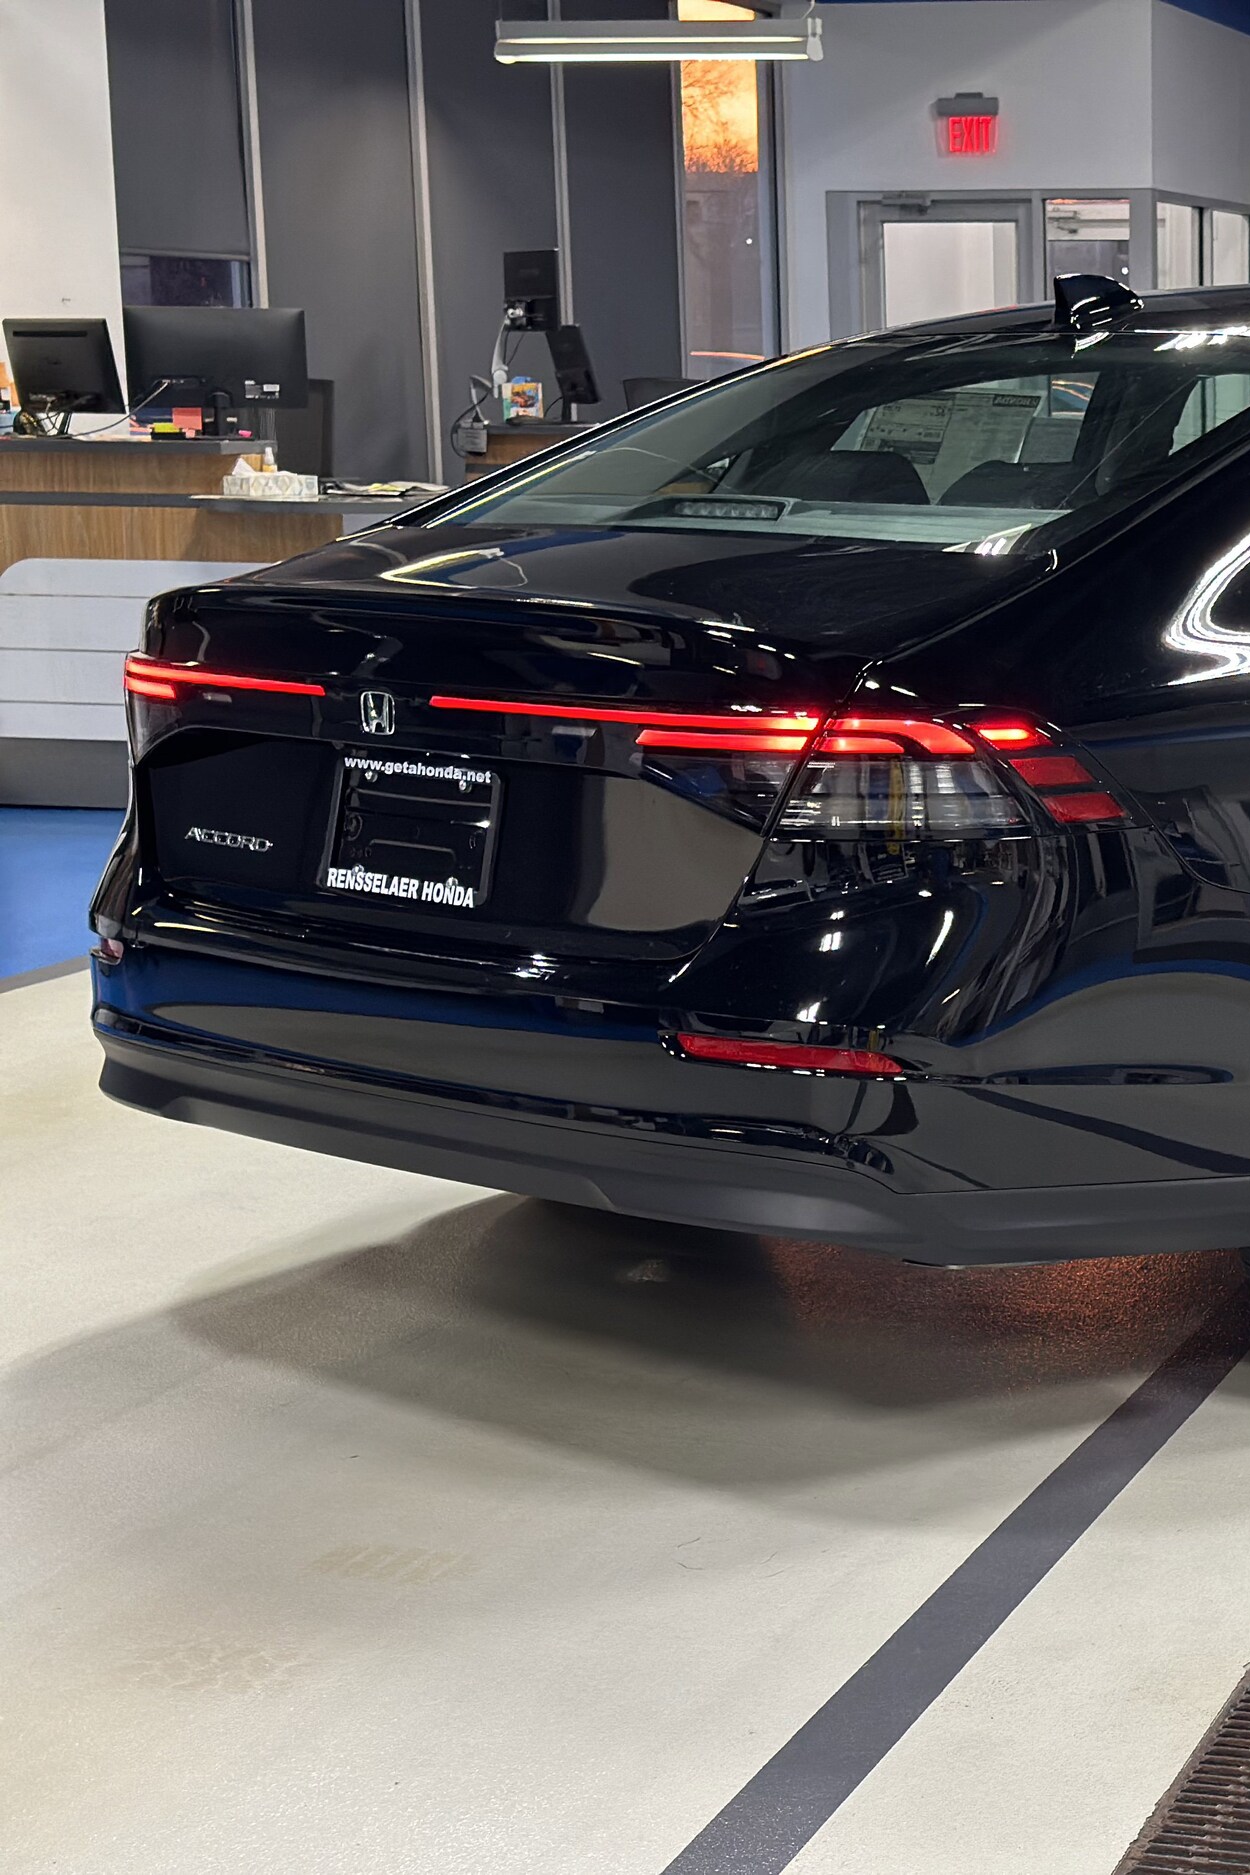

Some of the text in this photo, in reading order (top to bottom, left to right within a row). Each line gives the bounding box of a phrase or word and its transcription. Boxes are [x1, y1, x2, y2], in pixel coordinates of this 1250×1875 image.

[948, 116, 992, 152] EXIT
[344, 757, 492, 783] www.getahonda.net
[184, 827, 270, 852] ACCORD
[327, 867, 475, 908] RENSSELAER HONDA
